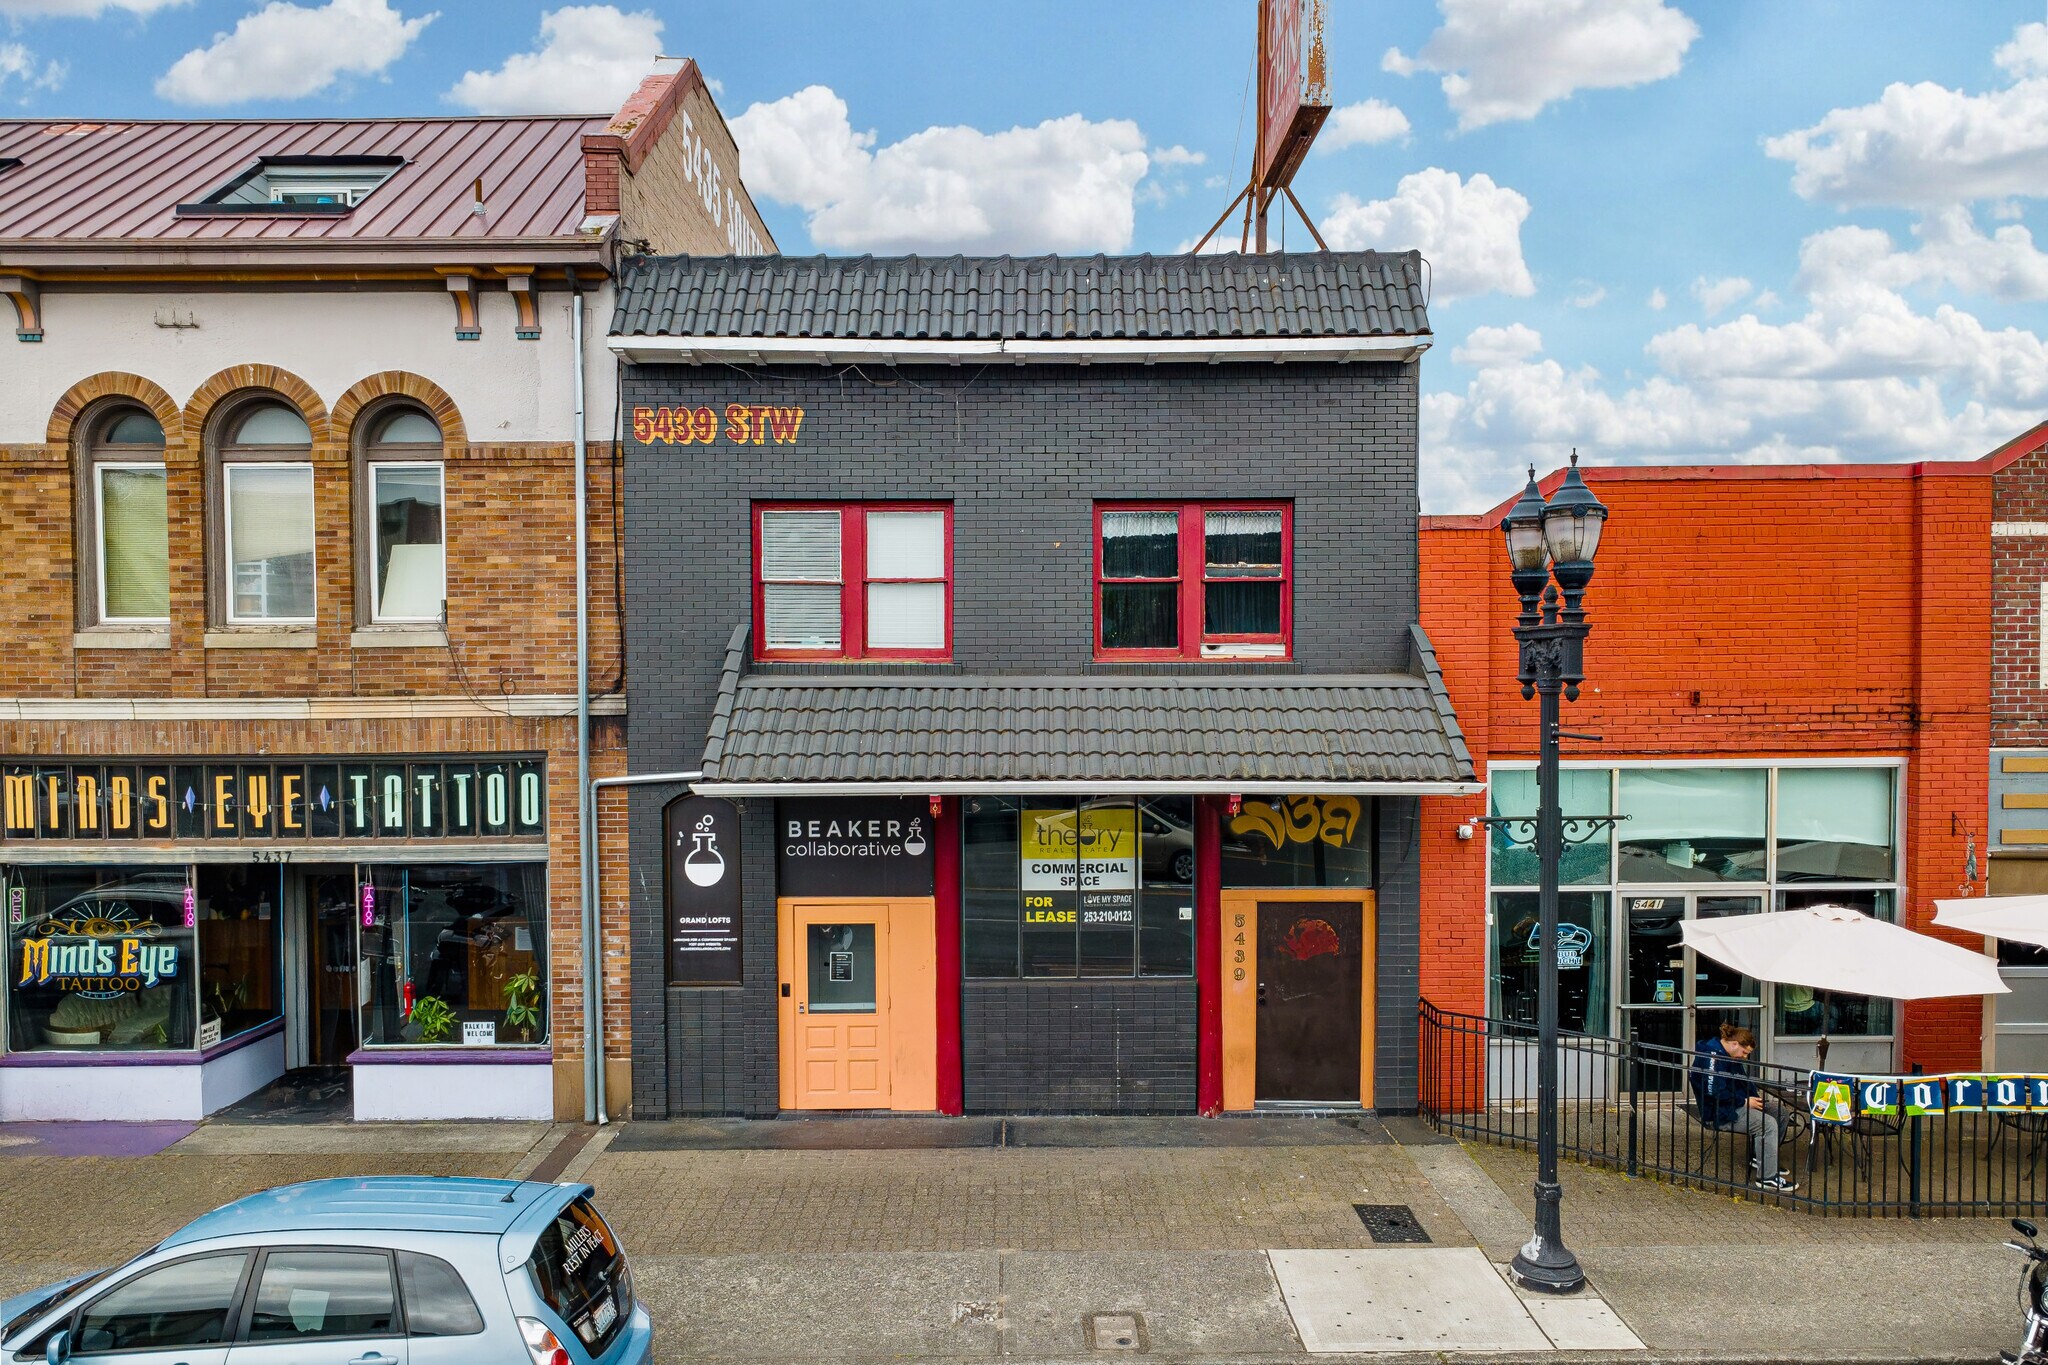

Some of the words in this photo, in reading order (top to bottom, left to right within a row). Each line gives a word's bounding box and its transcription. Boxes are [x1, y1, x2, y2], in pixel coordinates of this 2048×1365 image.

[683, 109, 722, 228] 5435
[633, 406, 718, 445] 5439
[724, 402, 804, 445] STW
[4, 775, 167, 829] MINDS
[215, 774, 302, 828] EYE
[350, 773, 539, 828] TATTOO
[788, 820, 901, 838] BEAKER
[786, 841, 901, 856] collaborative
[252, 851, 293, 864] 5437
[1031, 863, 1129, 874] COMMERCIAL
[1060, 876, 1100, 886] SPACE
[11, 889, 22, 922] OPEN
[364, 886, 374, 925] TATTOO
[1025, 896, 1053, 907] FOR
[1101, 895, 1111, 903] MY
[1112, 894, 1132, 903] SPACE
[1634, 899, 1661, 909] 5441
[184, 888, 194, 927] TATTOO
[679, 916, 707, 924] GRAND
[708, 916, 731, 924] LOFTS
[1025, 911, 1077, 923] LEASE
[1083, 910, 1132, 922] 253-210-0123
[1234, 914, 1246, 981] 5439
[18, 938, 116, 988] Minds
[120, 938, 179, 989] Eye
[1558, 956, 1581, 965] IGHT
[56, 977, 140, 991] TATTOO
[562, 1251, 583, 1276] REST
[579, 1243, 591, 1259] IN
[588, 1228, 605, 1252] PEACE
